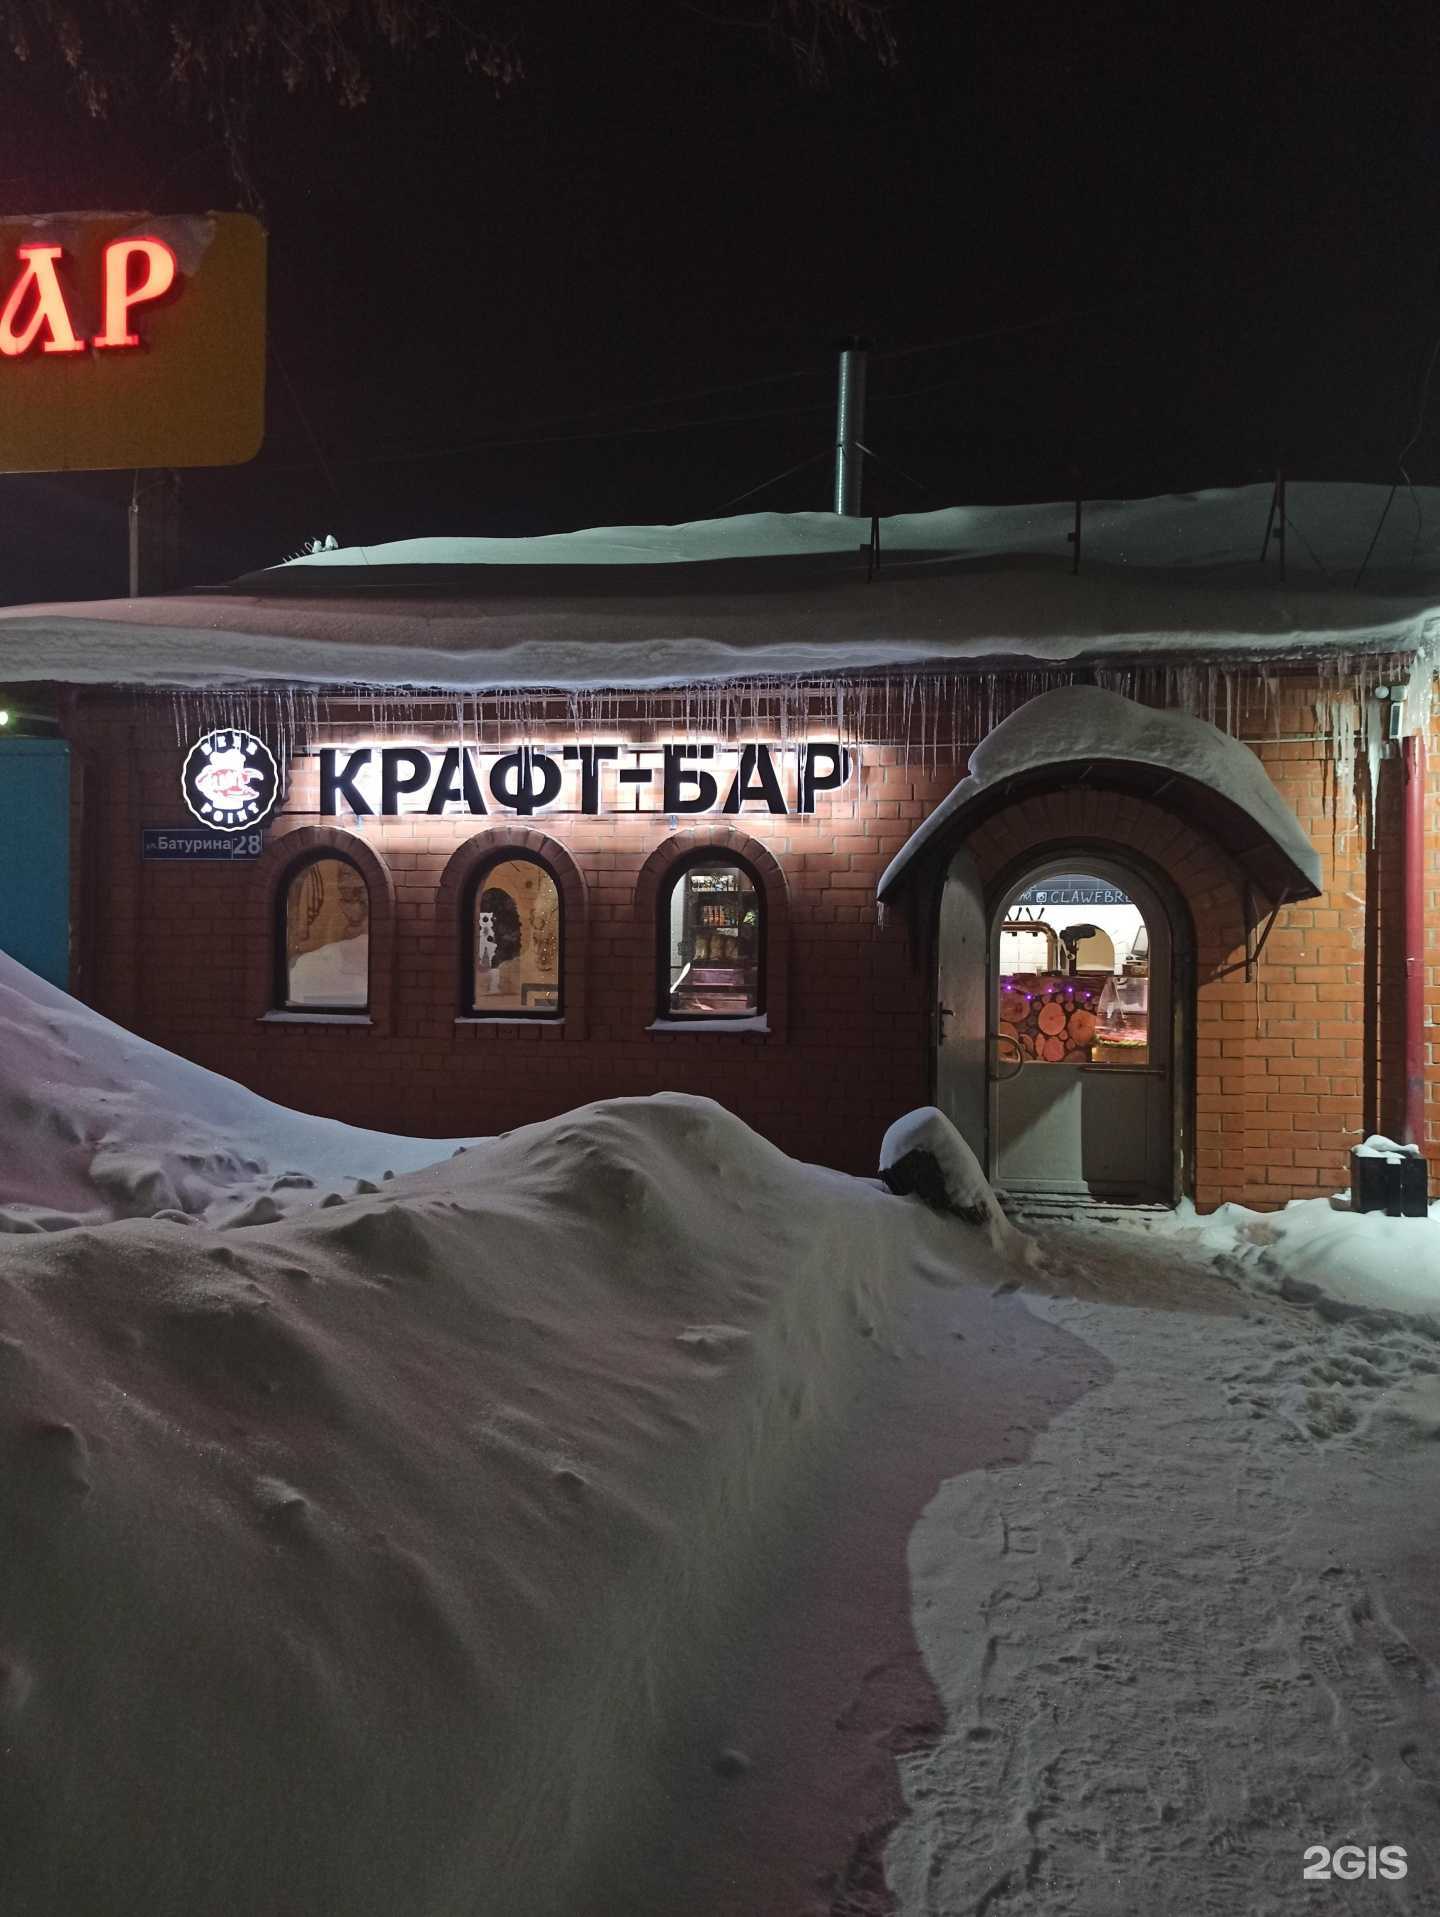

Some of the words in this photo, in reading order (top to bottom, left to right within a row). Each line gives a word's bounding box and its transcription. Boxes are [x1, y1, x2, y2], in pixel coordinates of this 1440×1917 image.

[319, 743, 850, 816] КРАФТ-БАР
[158, 836, 232, 853] Батурина
[233, 835, 261, 855] 28
